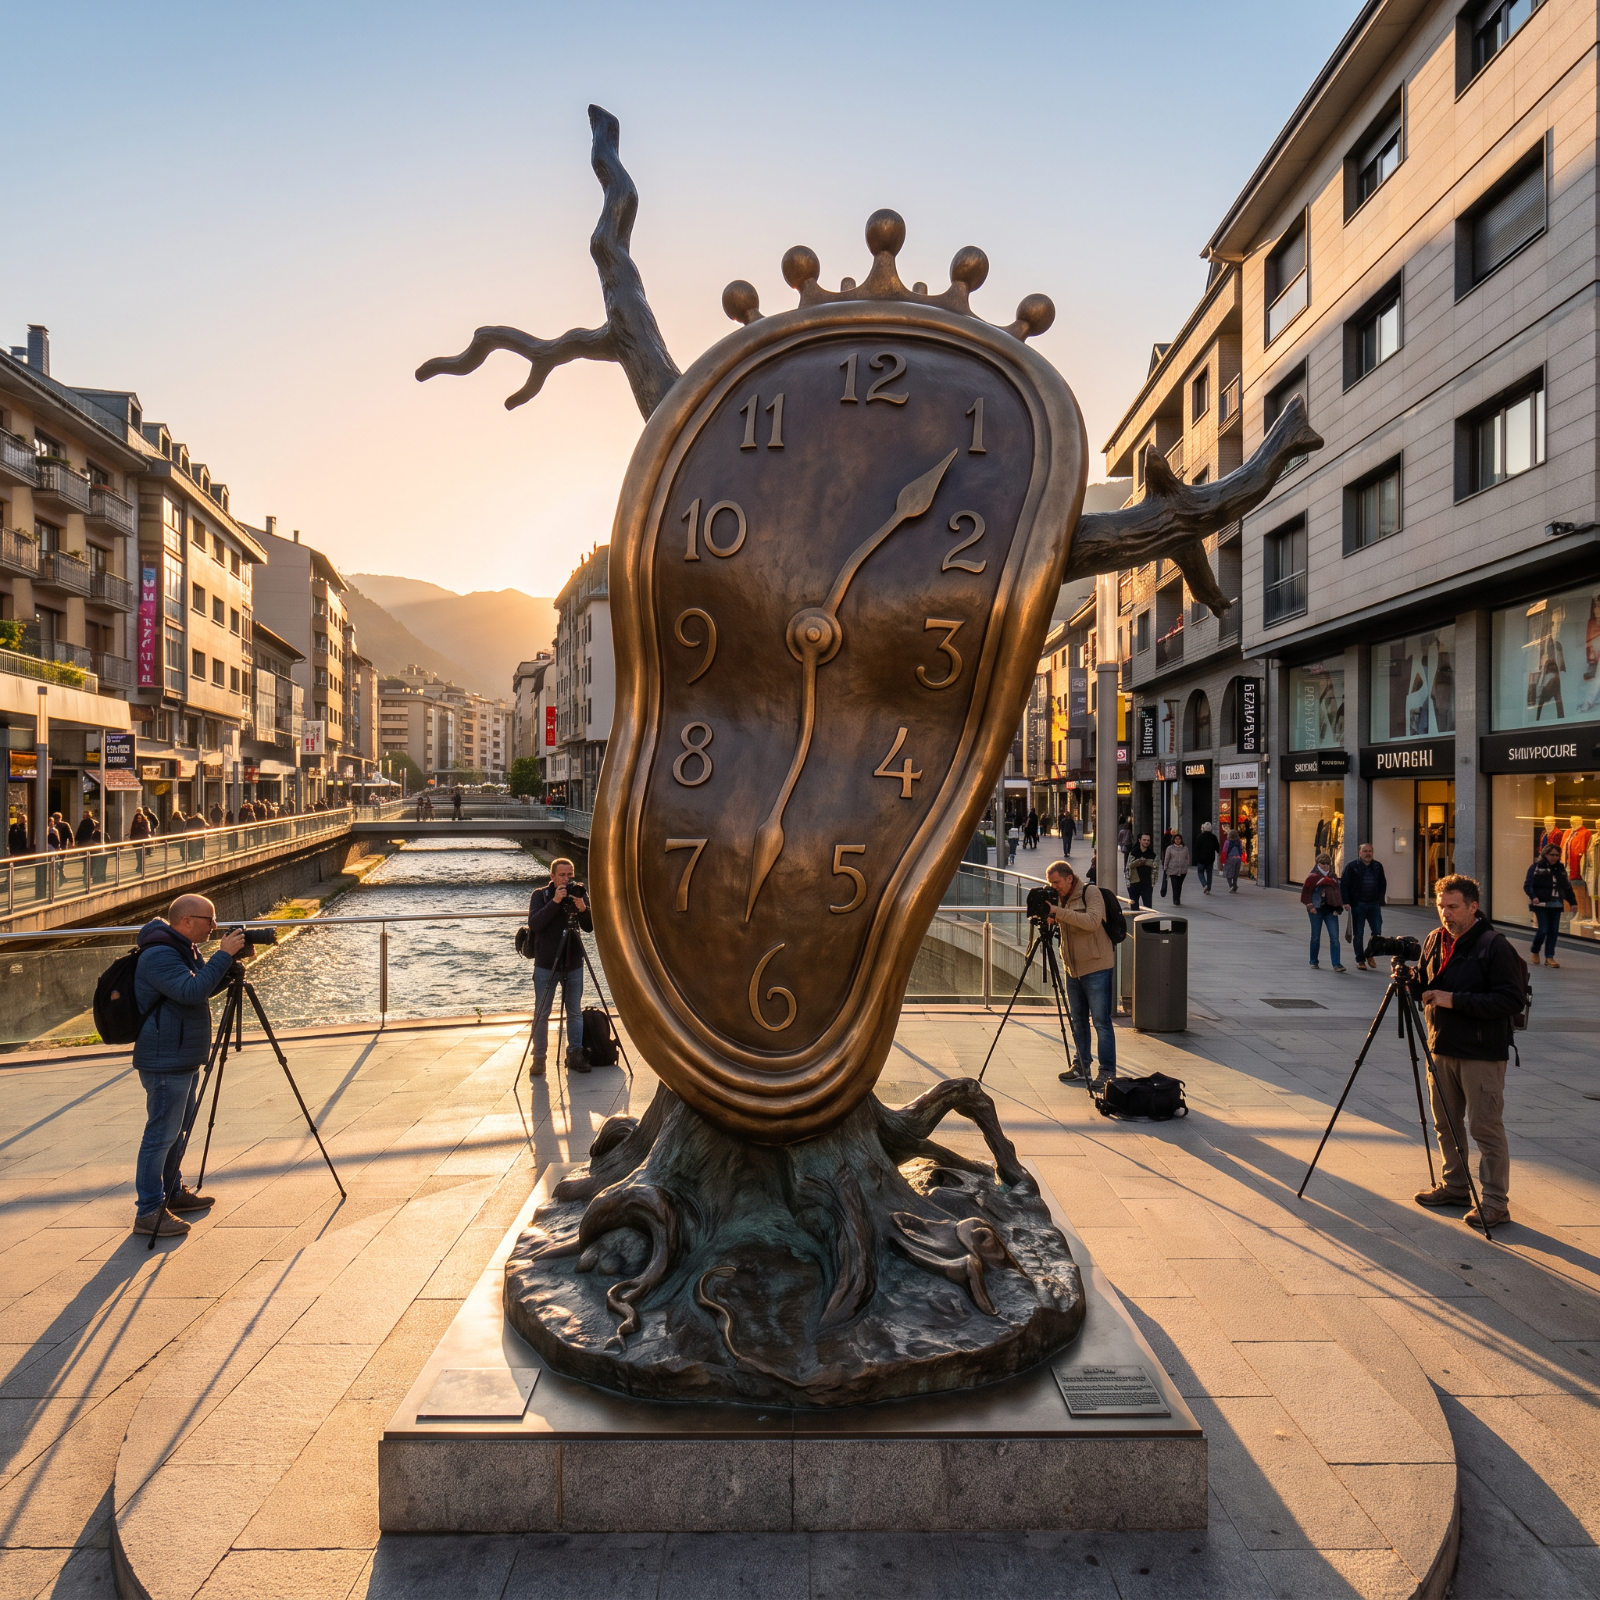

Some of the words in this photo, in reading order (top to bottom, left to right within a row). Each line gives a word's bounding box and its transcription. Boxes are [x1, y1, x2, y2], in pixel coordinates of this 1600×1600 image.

[839, 351, 910, 406] 12
[739, 393, 785, 450] 11
[966, 397, 988, 455] 1
[681, 498, 748, 562] 10
[941, 509, 988, 574] 2
[674, 607, 718, 686] 9
[914, 617, 967, 691] 3
[672, 721, 713, 786] 8
[873, 726, 923, 798] 4
[664, 838, 710, 912] 7
[829, 844, 868, 914] 5
[748, 942, 798, 1032] 6
